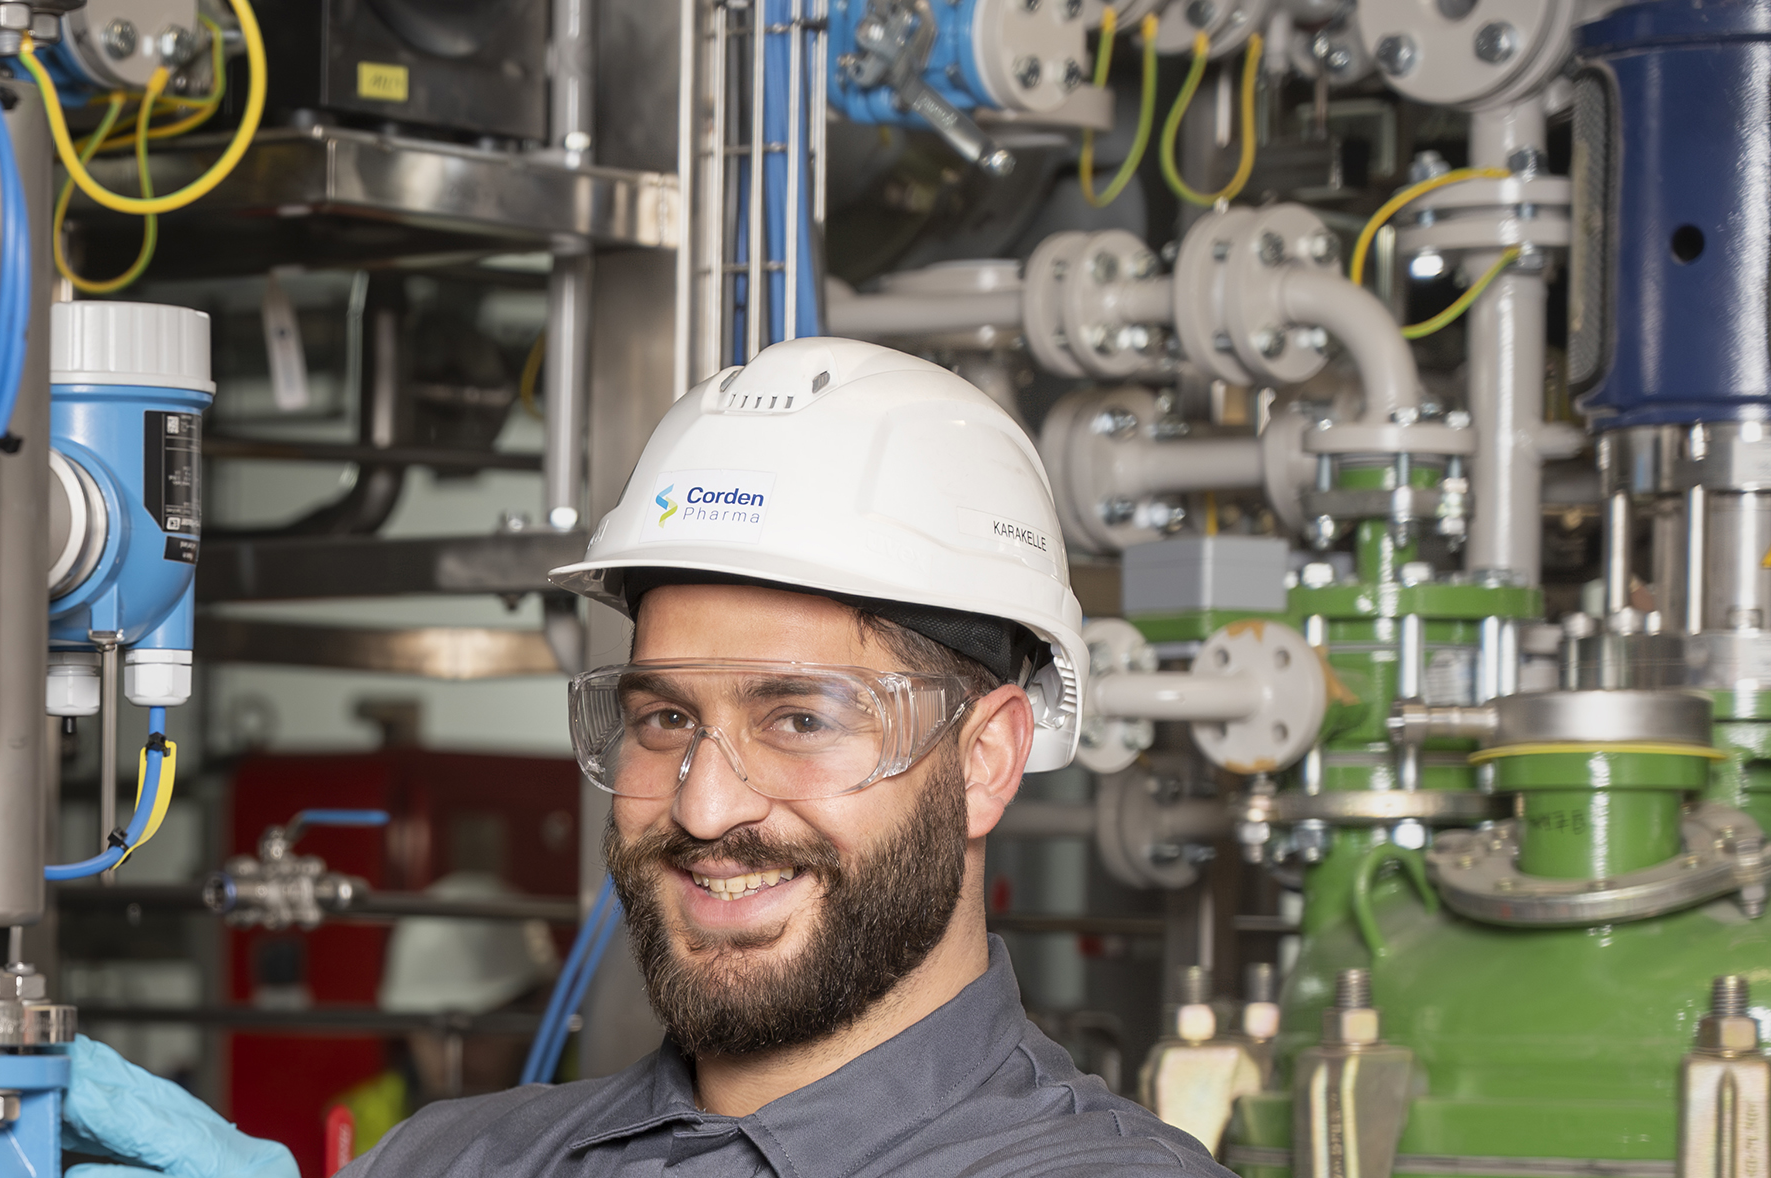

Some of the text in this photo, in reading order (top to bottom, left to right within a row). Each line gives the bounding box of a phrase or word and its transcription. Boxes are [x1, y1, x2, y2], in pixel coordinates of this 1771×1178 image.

[686, 486, 764, 507] Corden
[683, 506, 760, 523] Pharma
[993, 520, 1047, 551] KARAKELLE
